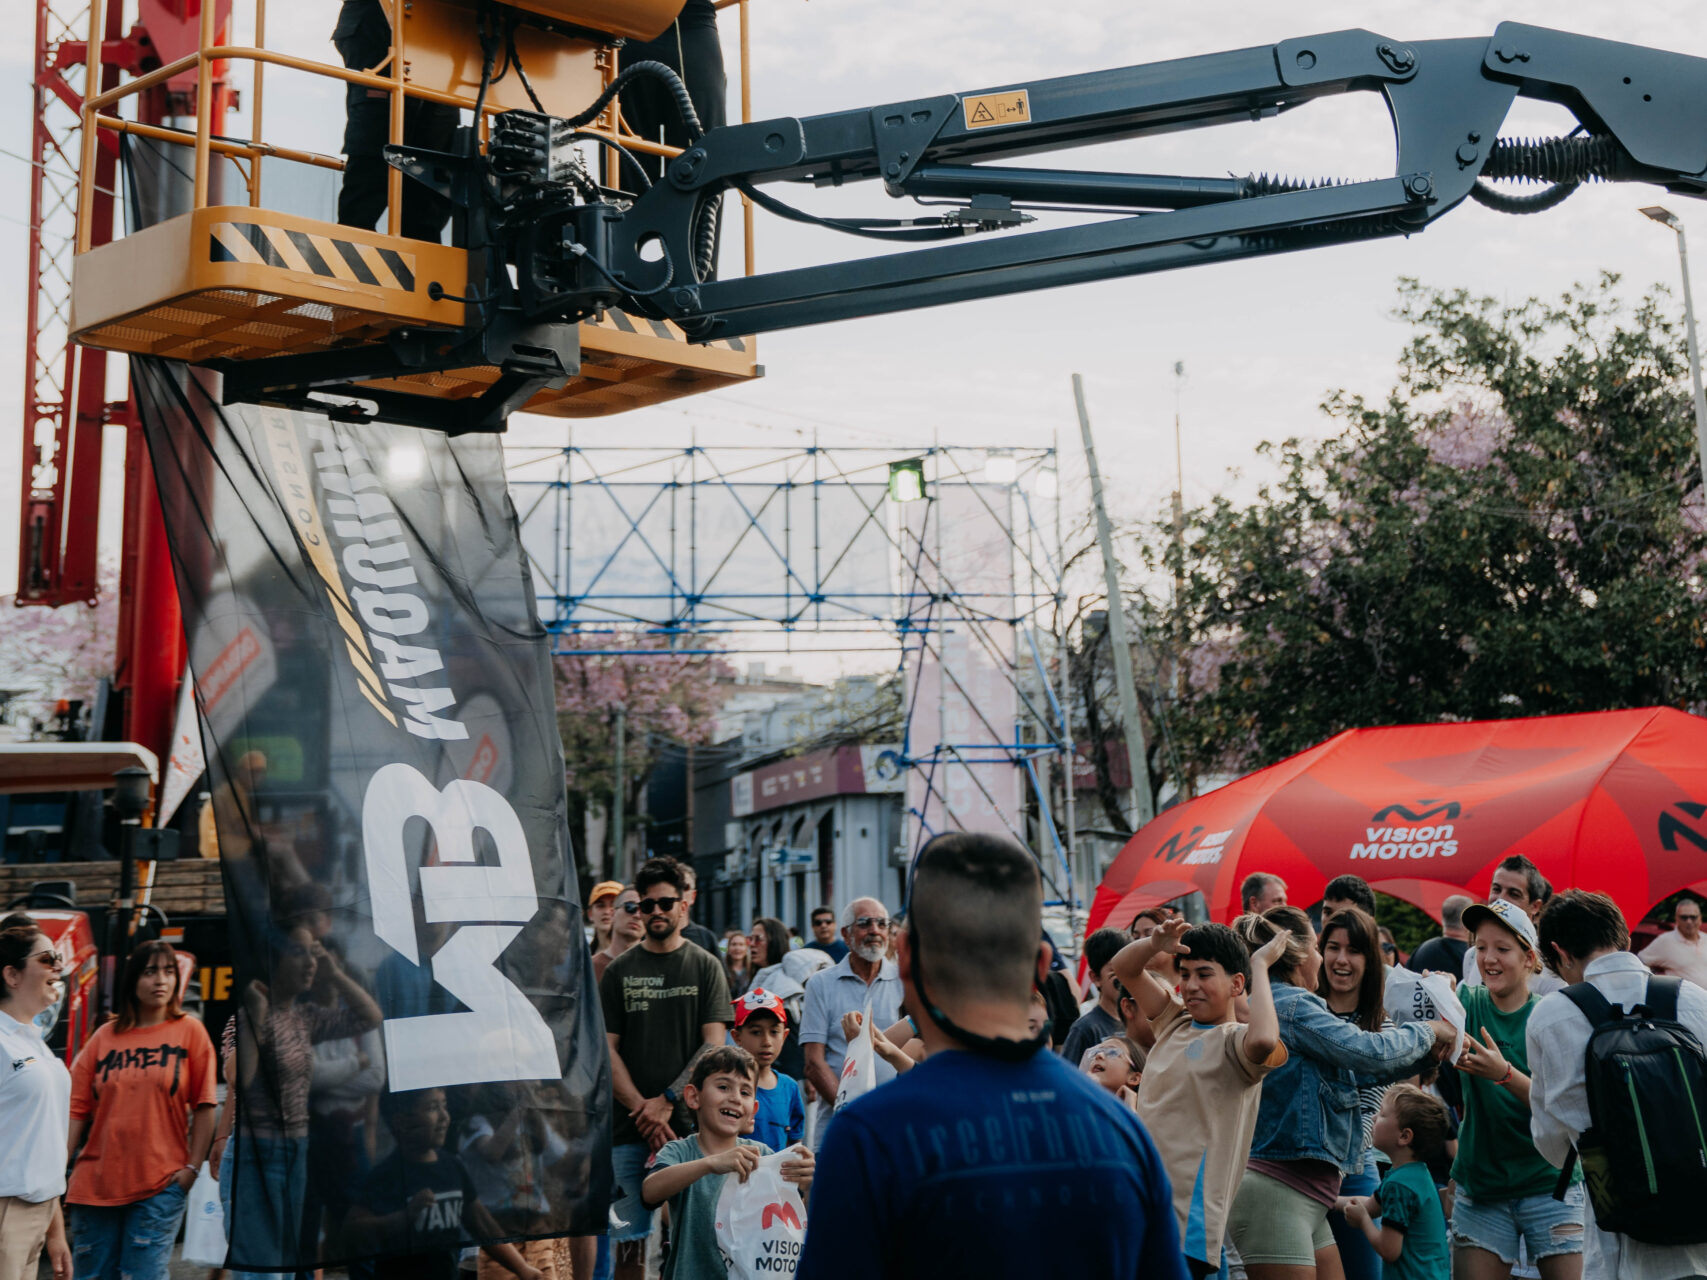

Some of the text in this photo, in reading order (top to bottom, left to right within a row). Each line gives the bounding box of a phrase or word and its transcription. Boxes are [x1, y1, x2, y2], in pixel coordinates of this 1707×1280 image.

[623, 975, 665, 987] Narrow
[623, 985, 699, 1000] Performance
[624, 999, 649, 1013] Line
